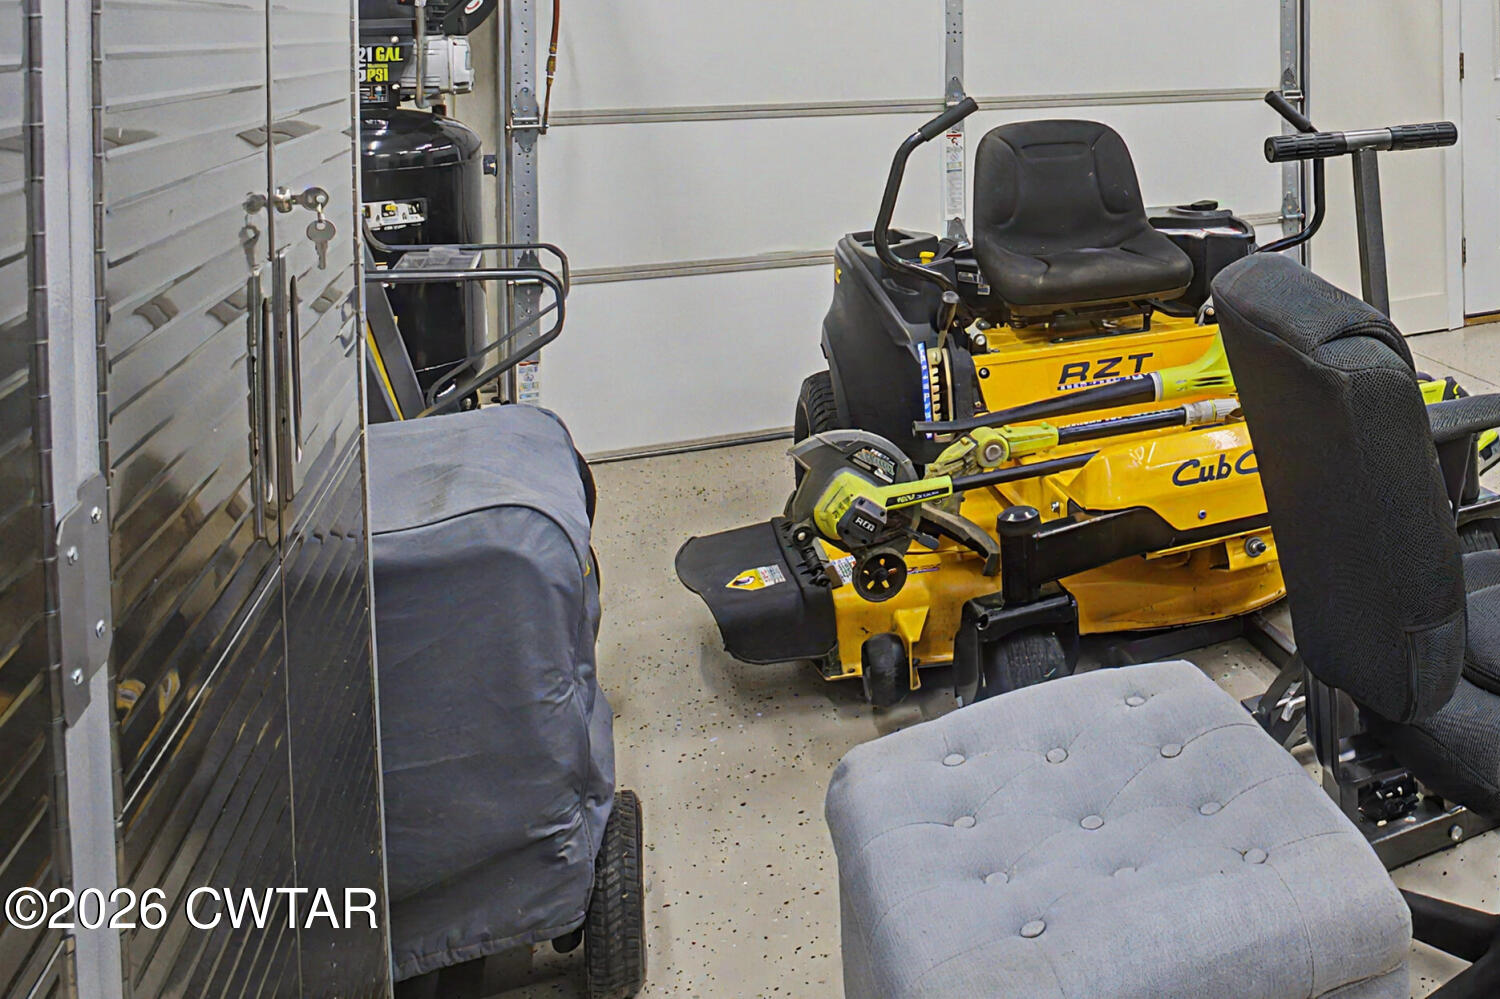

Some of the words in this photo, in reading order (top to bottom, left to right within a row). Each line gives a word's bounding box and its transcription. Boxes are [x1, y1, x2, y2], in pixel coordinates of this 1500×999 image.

[375, 46, 404, 62] GAL
[367, 68, 389, 83] PSI
[1058, 352, 1154, 384] RZT
[1172, 453, 1232, 487] Cub
